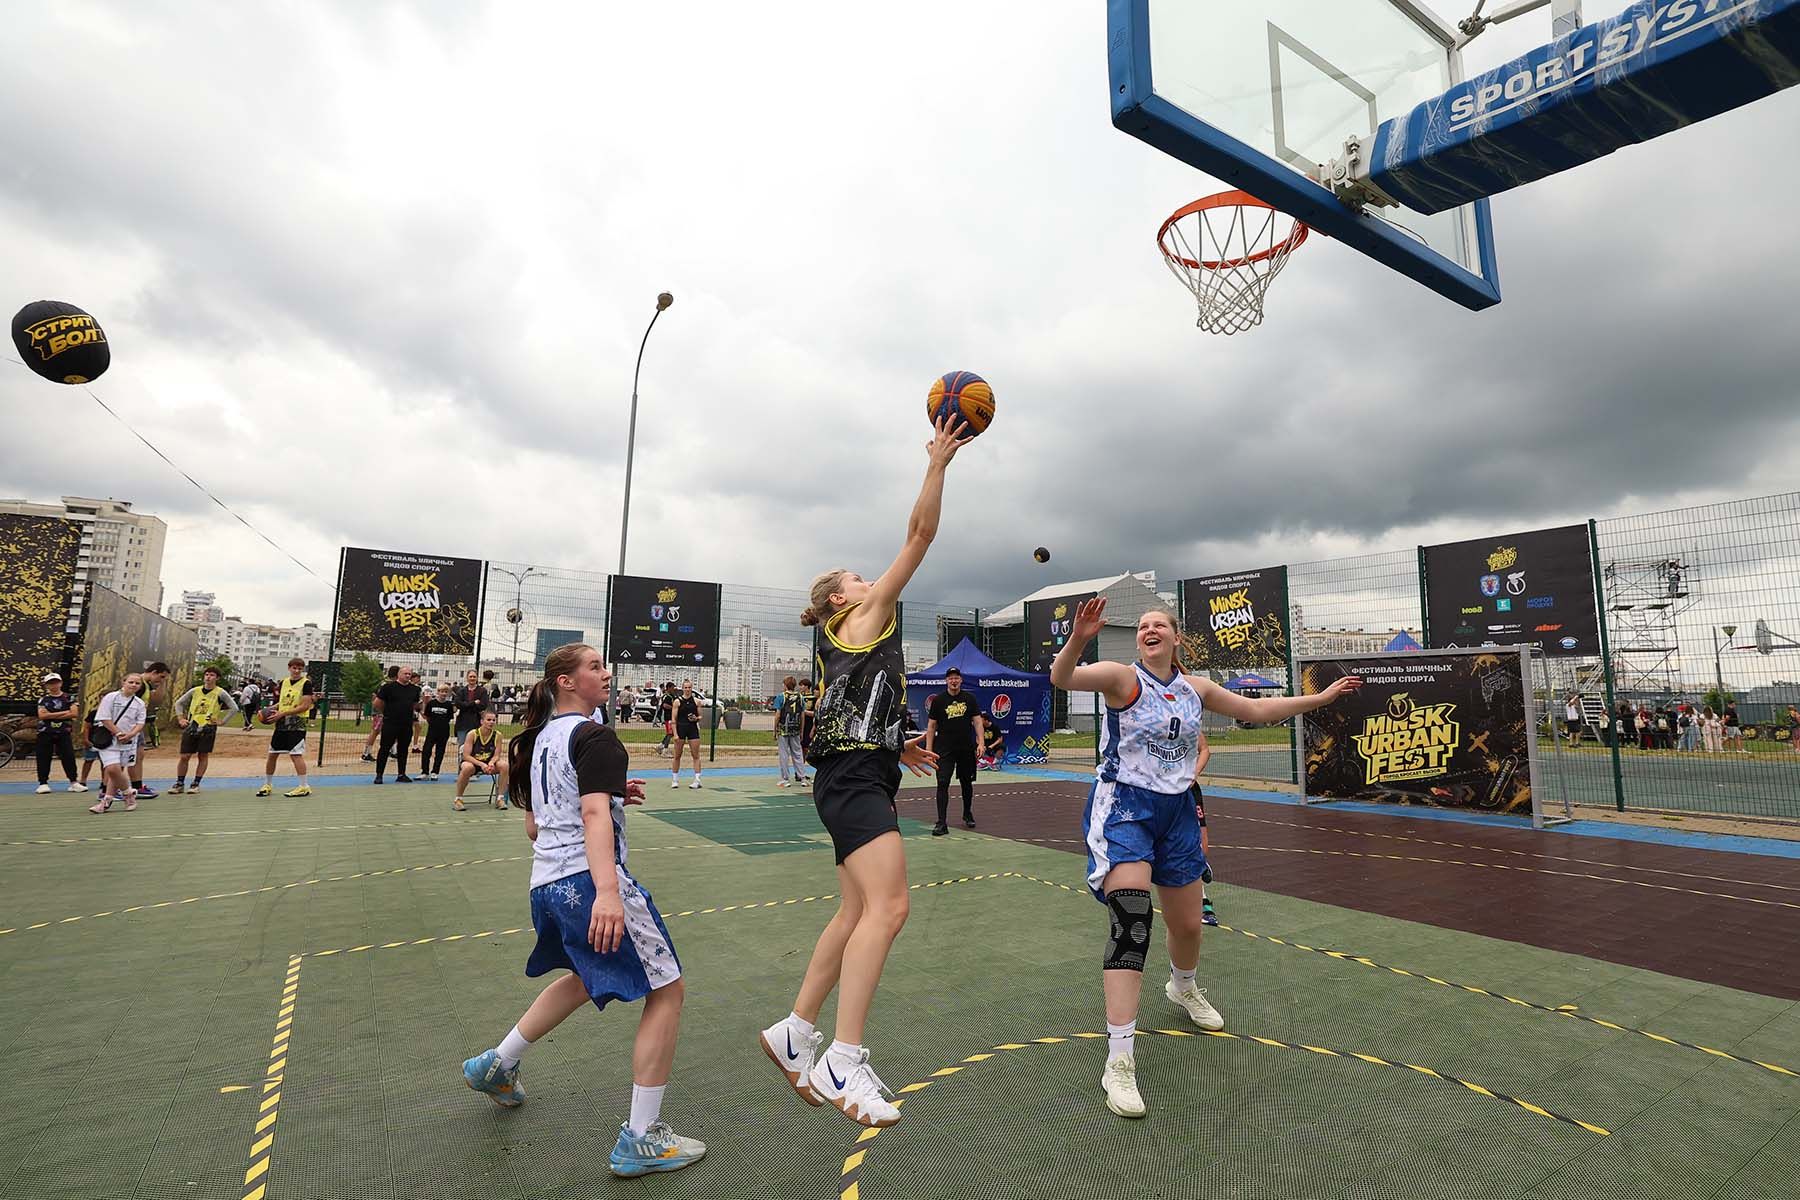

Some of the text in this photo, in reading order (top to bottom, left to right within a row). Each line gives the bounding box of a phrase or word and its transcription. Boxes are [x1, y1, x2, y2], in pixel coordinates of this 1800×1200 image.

[34, 317, 91, 340] СТРИТ
[48, 329, 98, 353] БОЛ
[371, 553, 454, 566] ФЕСТИВАЛЬ УЛИЧНЫХ
[383, 562, 440, 572] ВИДОВ СПОРТА
[1200, 576, 1232, 586] ФЕСТИВАЛЬ
[379, 590, 440, 610] URBAN
[384, 608, 437, 629] FEST
[1209, 605, 1255, 631] URBAN
[1215, 623, 1253, 647] FEST
[1352, 665, 1404, 674] ФЕСТИВАЛЬ
[1366, 675, 1435, 684] ВИДОВ СПОРТА
[979, 679, 1030, 688] belarus.basketball
[1167, 717, 1181, 740] 9
[1366, 706, 1447, 736] MINSK
[1361, 724, 1452, 755] URBAN
[128, 754, 135, 762] 2
[1371, 745, 1444, 778] FEST
[540, 747, 549, 805] 1
